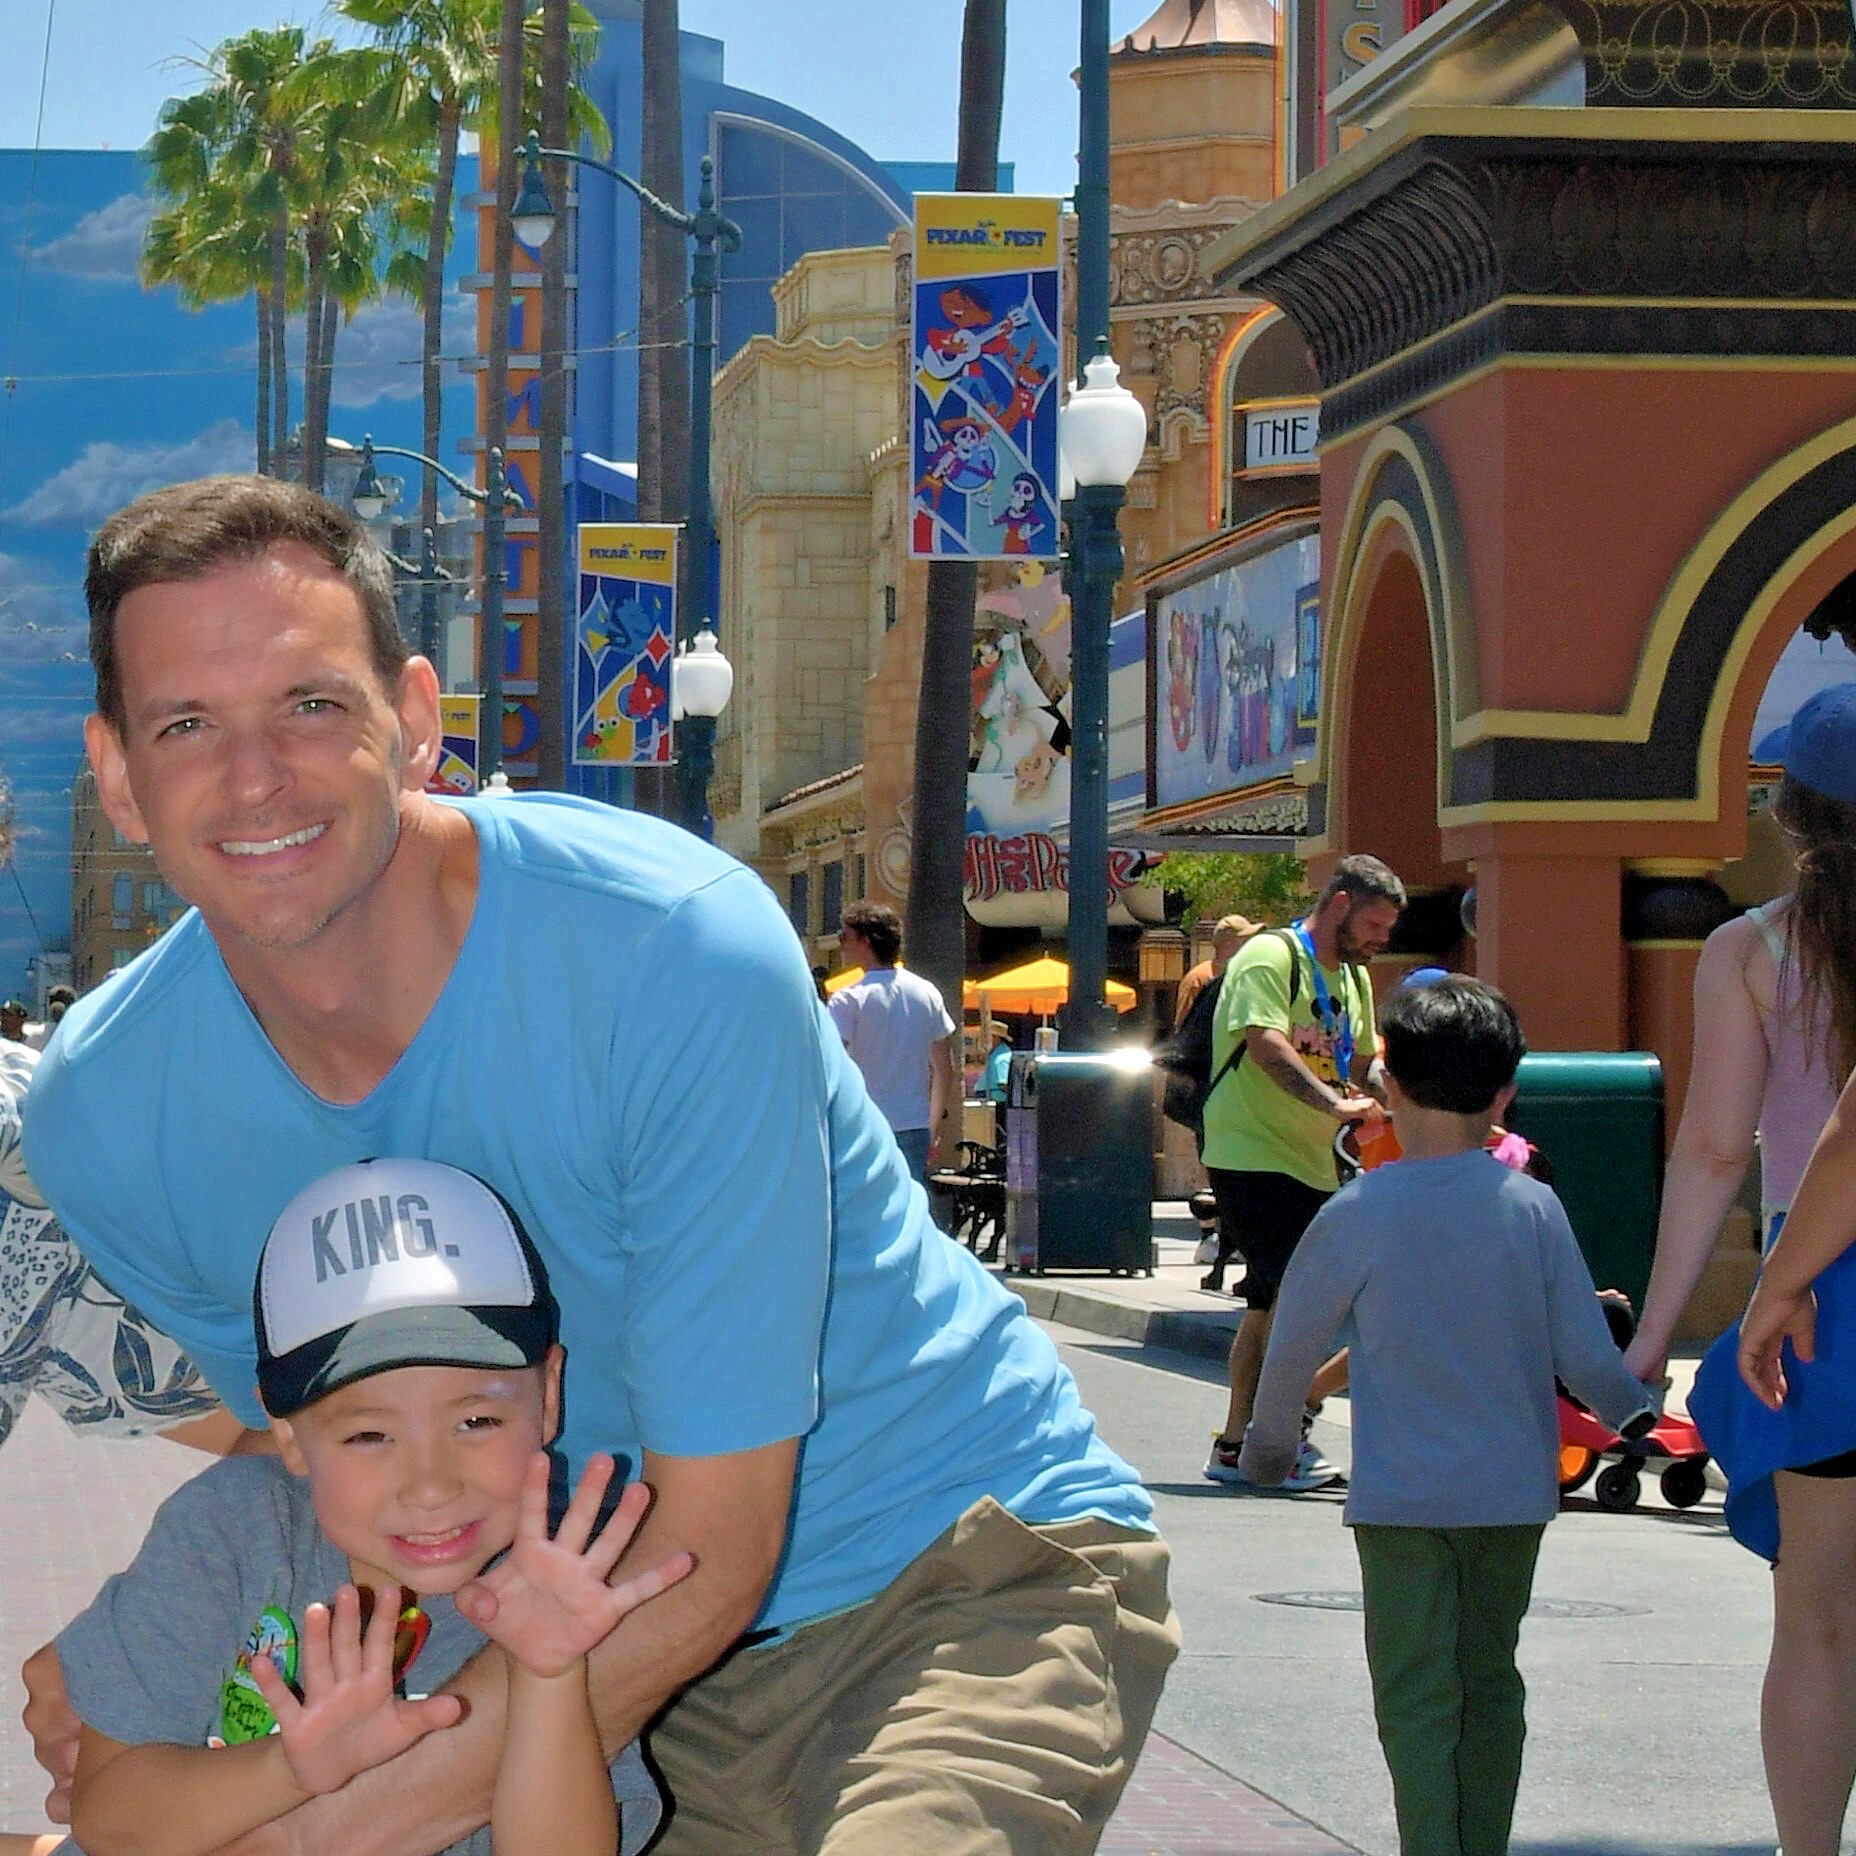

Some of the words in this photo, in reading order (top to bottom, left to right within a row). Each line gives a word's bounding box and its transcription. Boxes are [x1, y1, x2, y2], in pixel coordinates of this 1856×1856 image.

[927, 229, 989, 245] PIXAR
[1004, 230, 1046, 247] FEST
[309, 1193, 461, 1284] KING.
